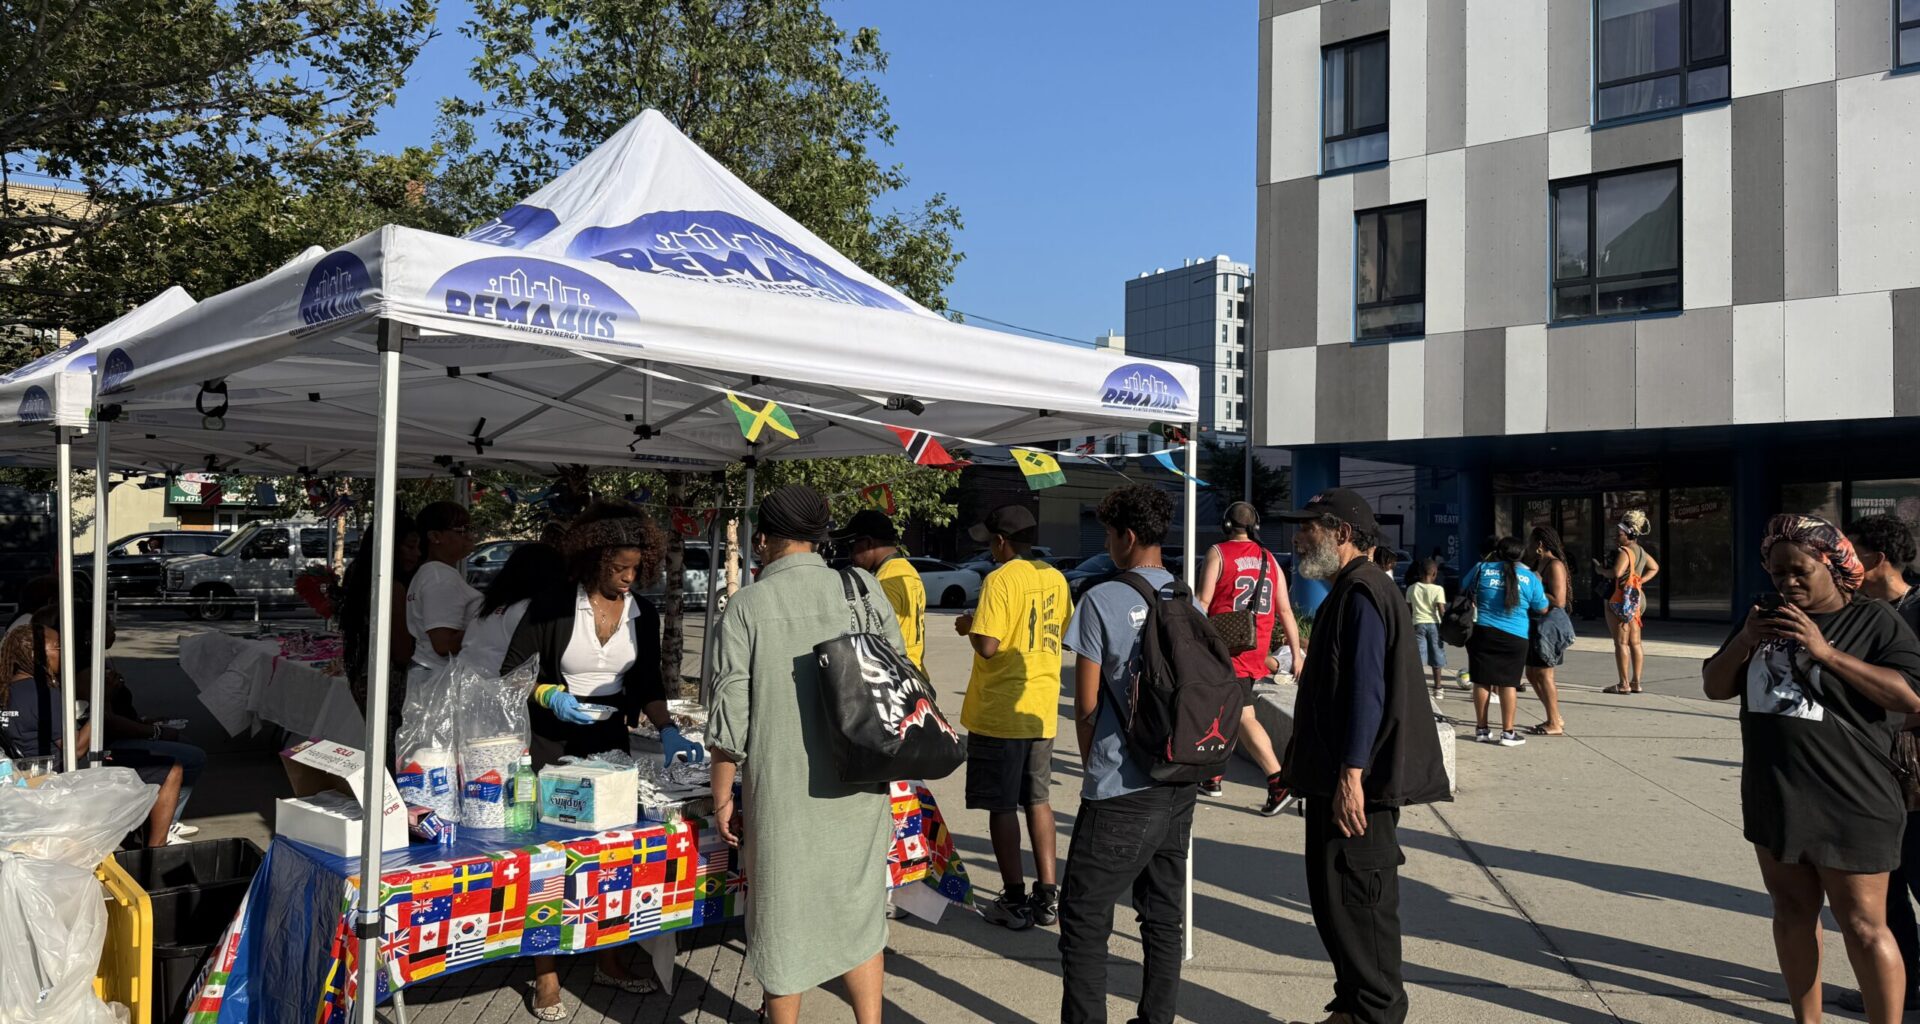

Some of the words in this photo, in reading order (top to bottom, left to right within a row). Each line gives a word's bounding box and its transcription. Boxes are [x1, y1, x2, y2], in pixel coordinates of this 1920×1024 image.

[513, 325, 544, 334] UNITED
[544, 329, 580, 341] SYNERGY
[1701, 502, 1718, 512] SOON
[550, 797, 587, 812] Napkins
